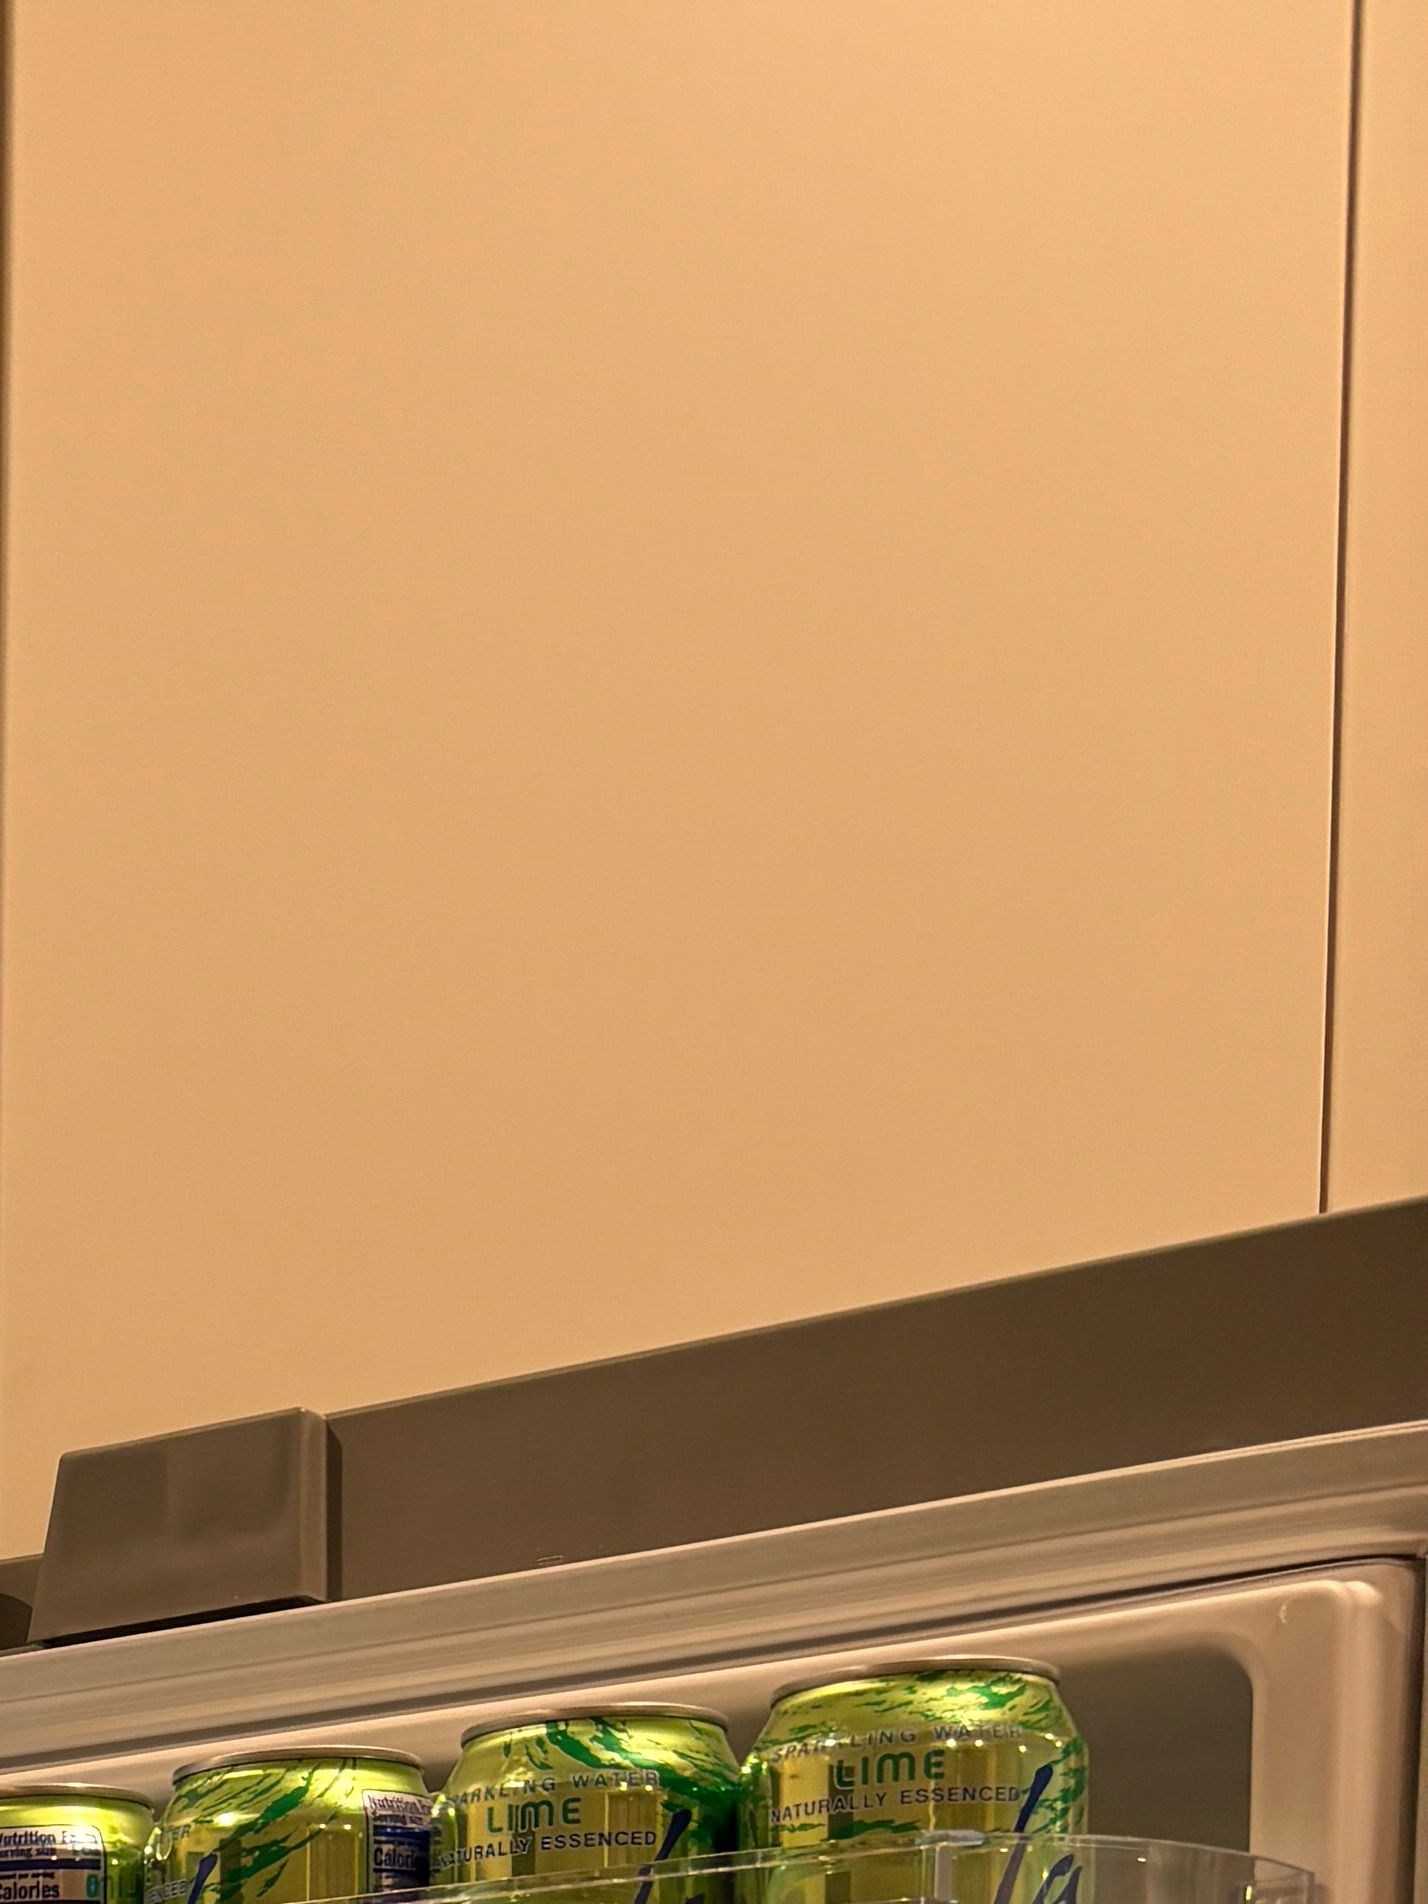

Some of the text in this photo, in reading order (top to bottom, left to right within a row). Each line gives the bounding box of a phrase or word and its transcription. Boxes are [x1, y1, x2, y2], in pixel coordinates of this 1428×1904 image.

[934, 1725, 1023, 1742] WATER
[572, 1769, 660, 1791] WATER
[834, 1750, 947, 1790] LIME
[487, 1796, 582, 1834] LIME
[771, 1786, 1020, 1824] NATURALLY ESSENCED
[540, 1830, 658, 1851] ESSENCED
[86, 1874, 101, 1899] 0
